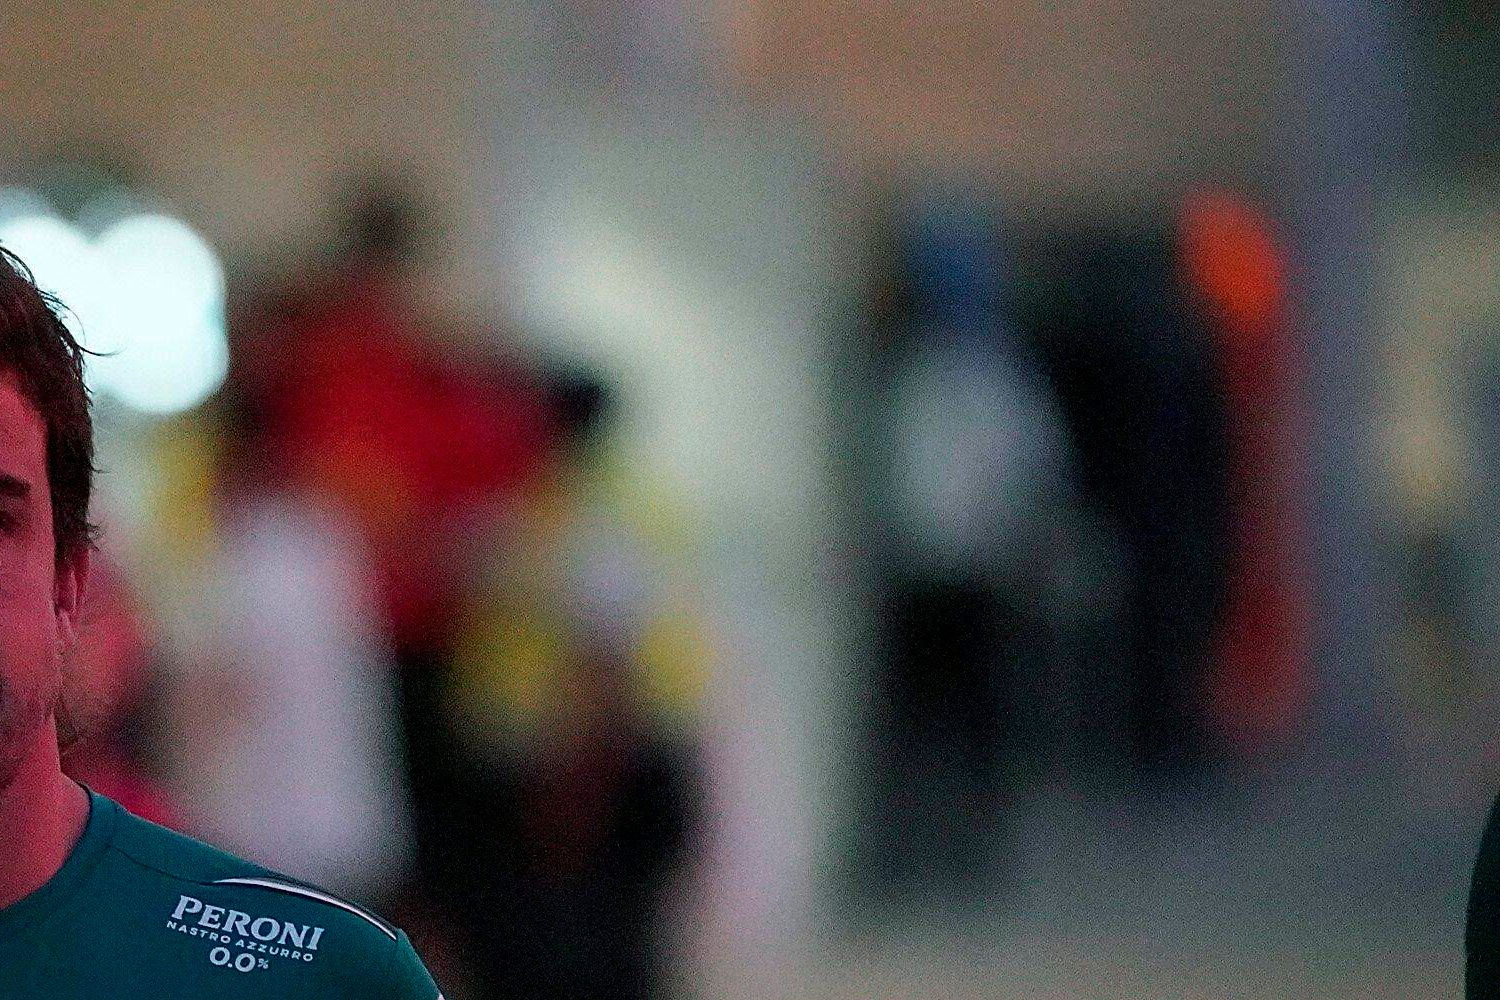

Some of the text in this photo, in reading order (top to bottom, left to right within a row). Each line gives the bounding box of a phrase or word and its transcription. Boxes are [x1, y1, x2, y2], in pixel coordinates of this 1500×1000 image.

[166, 920, 314, 962] NASTRO AZZURRO
[171, 894, 325, 951] PERONI
[209, 946, 269, 973] 0.0%
